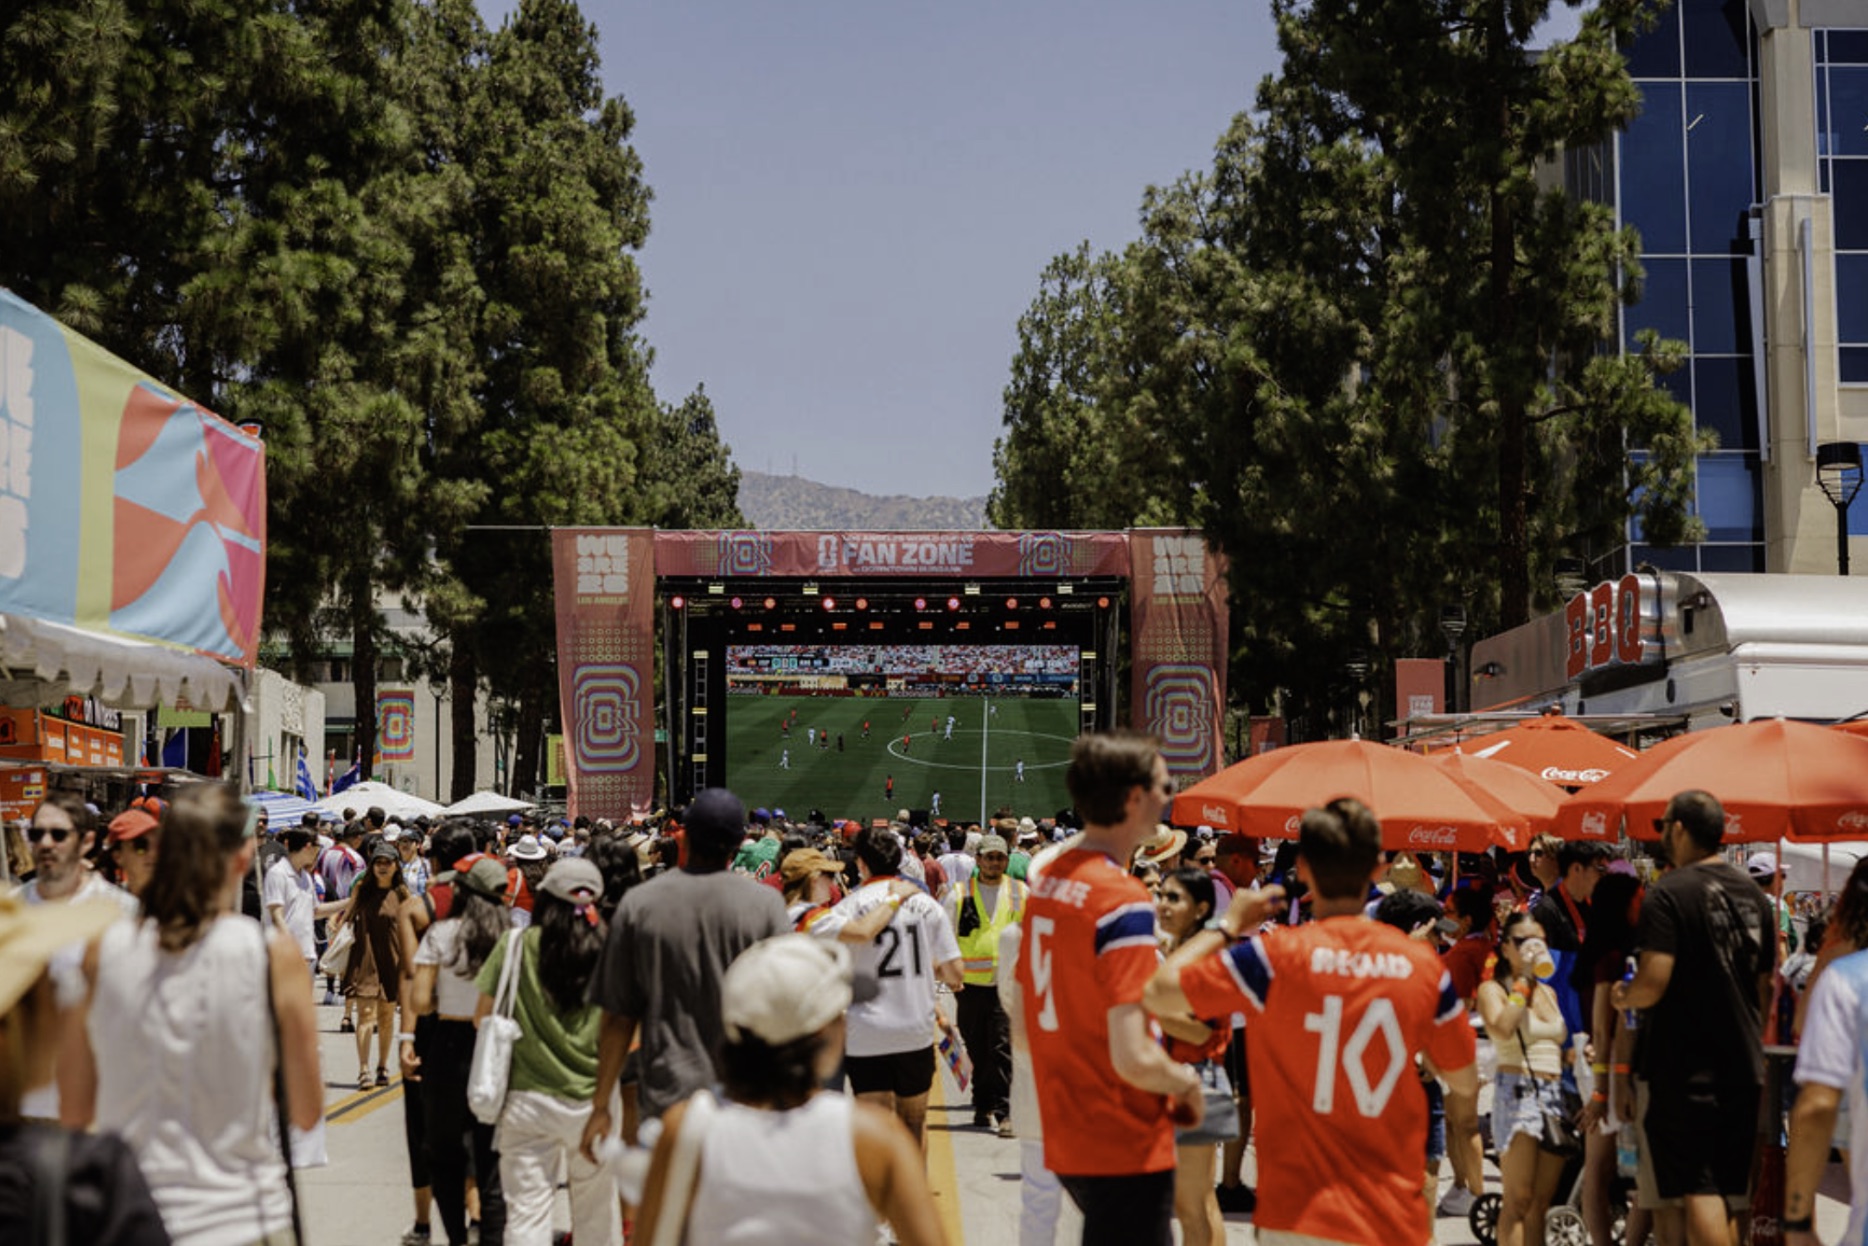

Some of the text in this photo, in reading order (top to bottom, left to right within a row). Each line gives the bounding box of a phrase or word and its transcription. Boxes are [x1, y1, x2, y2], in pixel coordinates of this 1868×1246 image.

[577, 534, 629, 556] WE
[842, 543, 974, 565] FAN ZONE
[1564, 573, 1645, 682] BBQ
[874, 924, 922, 979] 21
[1303, 994, 1409, 1118] 10
